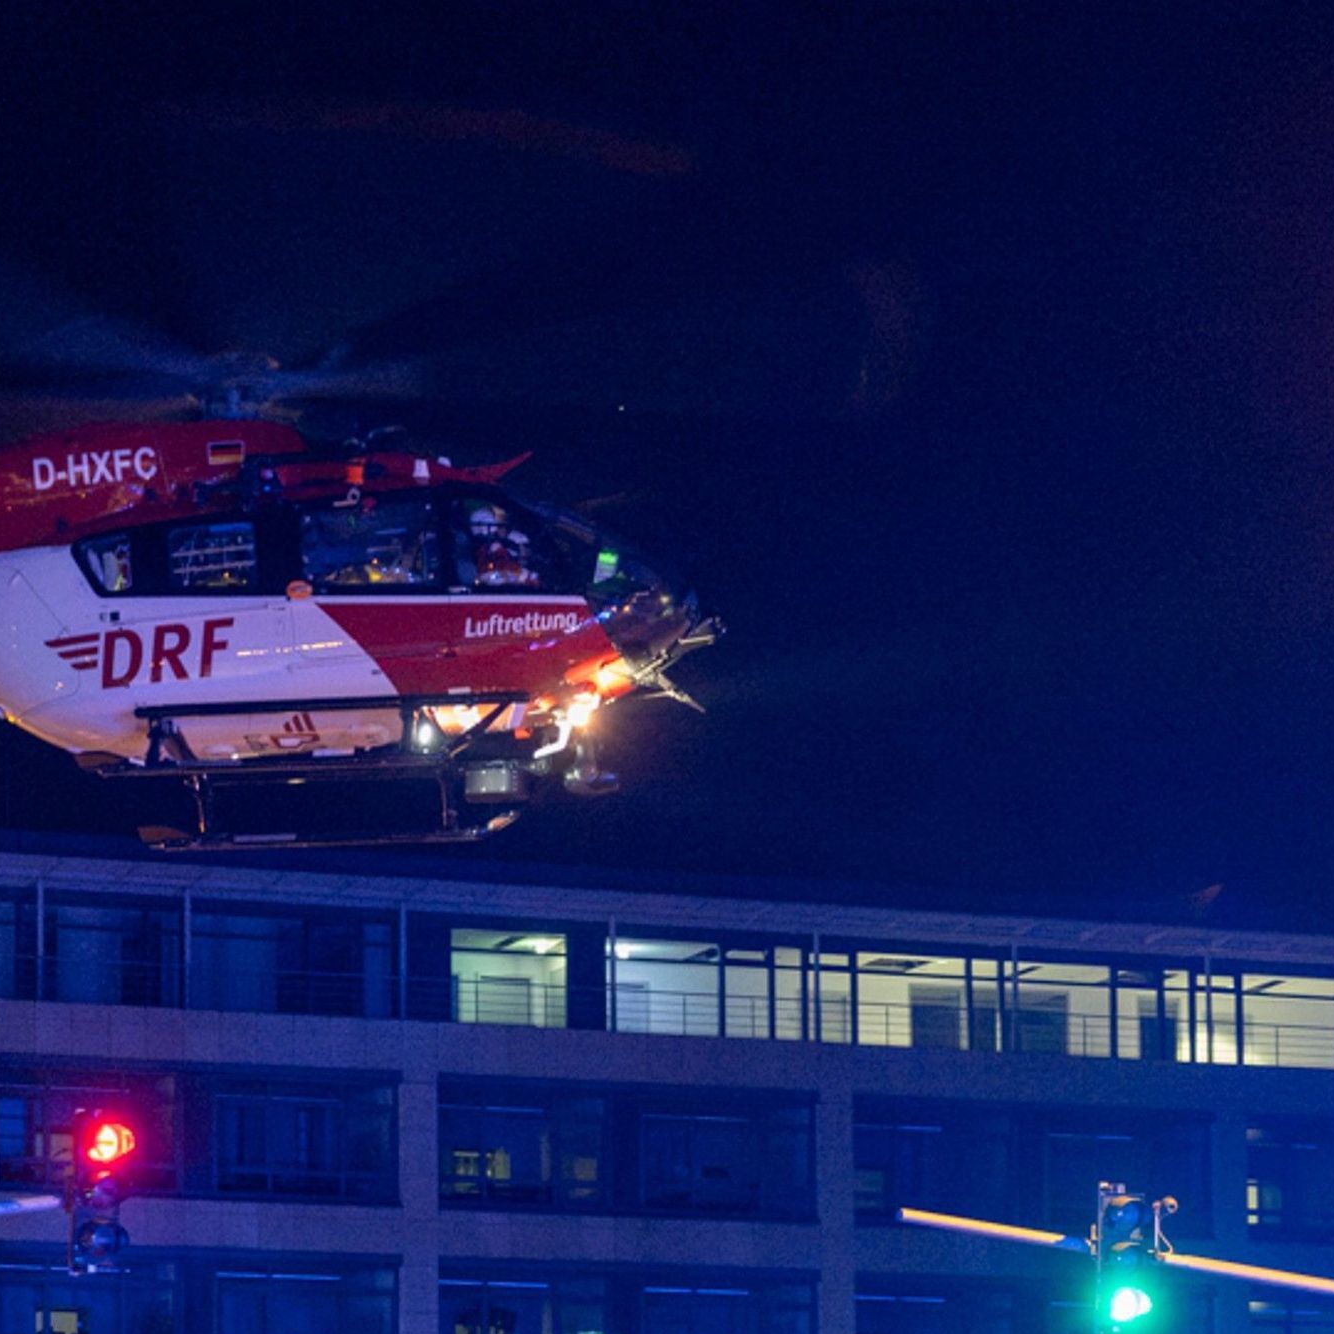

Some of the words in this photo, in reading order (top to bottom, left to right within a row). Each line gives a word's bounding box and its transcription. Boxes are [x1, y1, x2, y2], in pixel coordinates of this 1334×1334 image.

[32, 446, 157, 490] D-HXFC
[464, 601, 578, 638] Luftrettung
[101, 617, 235, 690] DRF
